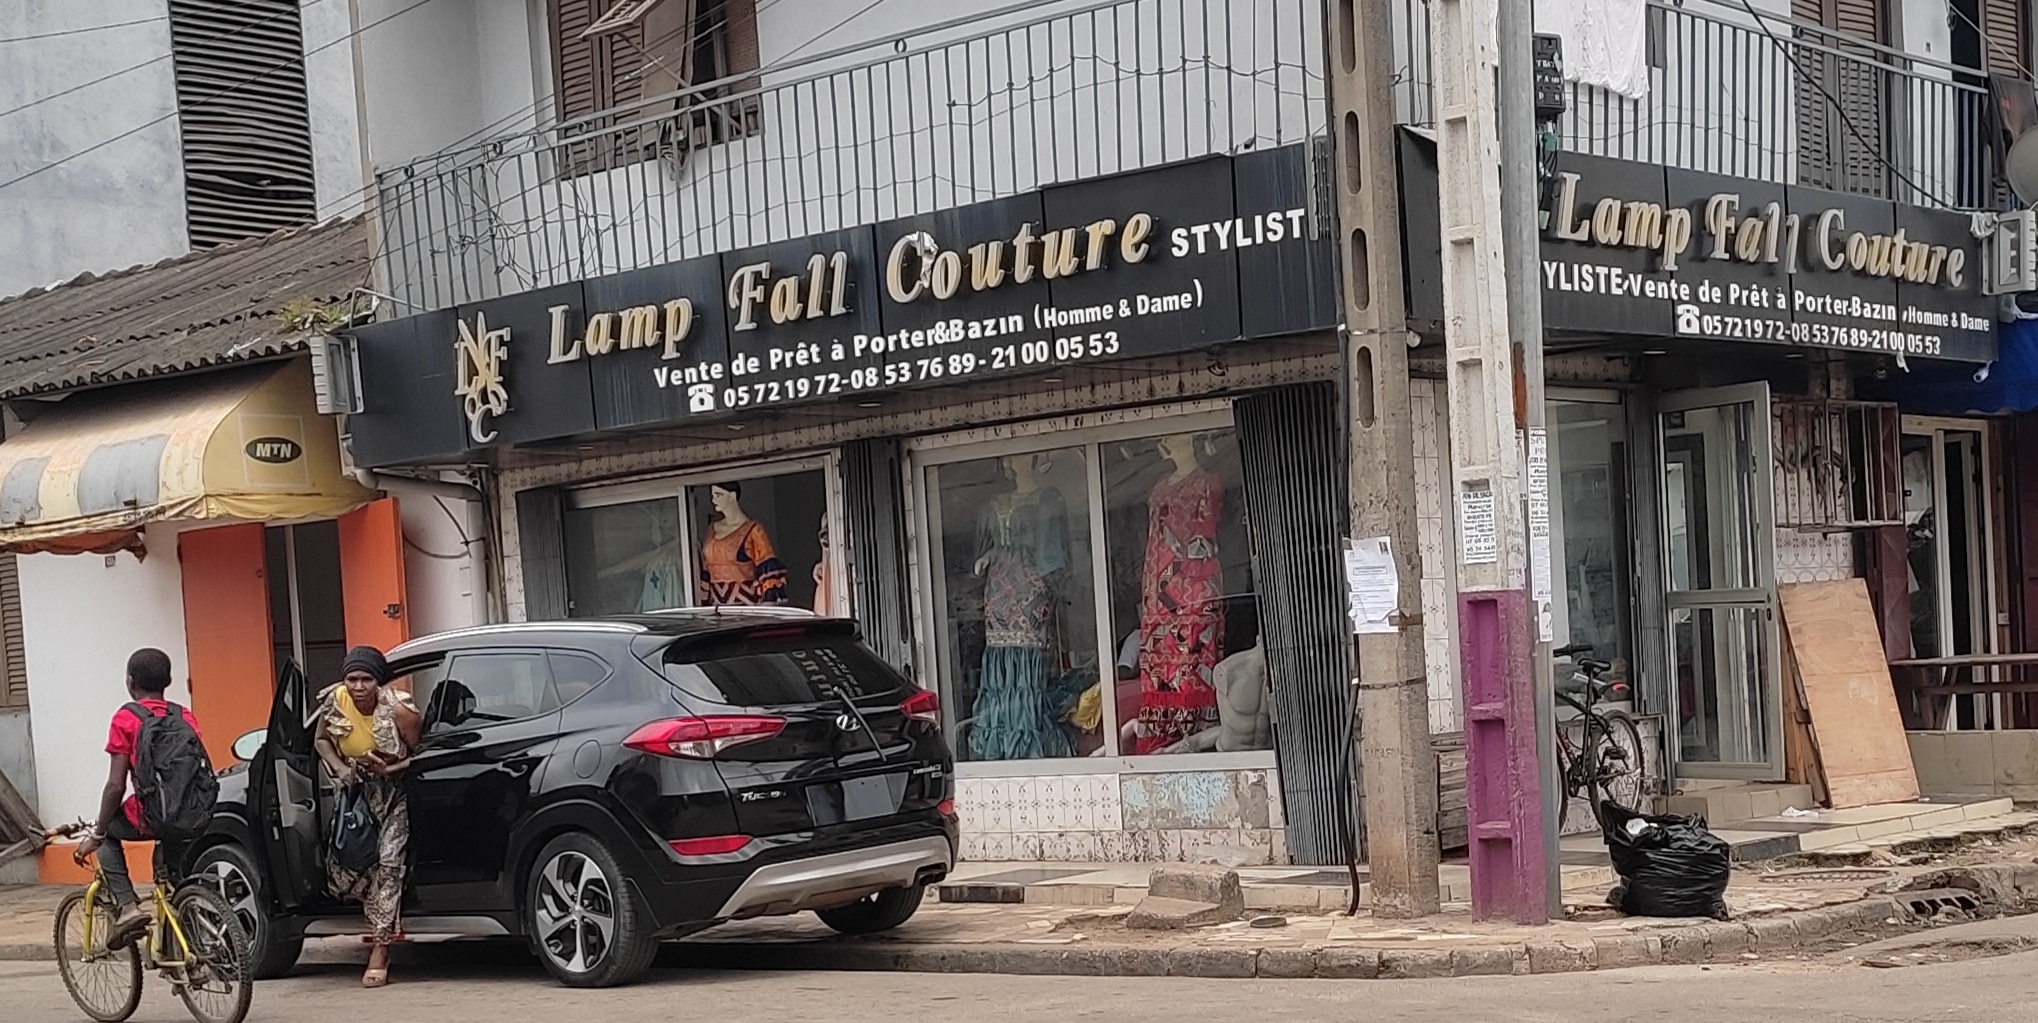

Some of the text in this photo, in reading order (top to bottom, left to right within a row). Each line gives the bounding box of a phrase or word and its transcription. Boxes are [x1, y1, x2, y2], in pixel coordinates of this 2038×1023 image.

[1171, 208, 1305, 257] STYLIST
[1557, 171, 1965, 288] Lamp Fall Couture
[547, 212, 1153, 365] Lamp Fall Couture
[1698, 279, 1722, 304] de
[1729, 283, 1769, 308] Prêt
[1776, 287, 1787, 310] à
[1951, 312, 1959, 328] &
[1960, 312, 1990, 332] Dame
[653, 361, 724, 388] Vente
[731, 352, 761, 376] de
[769, 341, 822, 370] Prêt
[831, 338, 846, 361] à
[1118, 298, 1132, 318] &
[1055, 335, 1084, 360] 05
[1089, 331, 1120, 356] 53
[256, 443, 291, 458] MTN
[740, 791, 787, 802] TUCON
